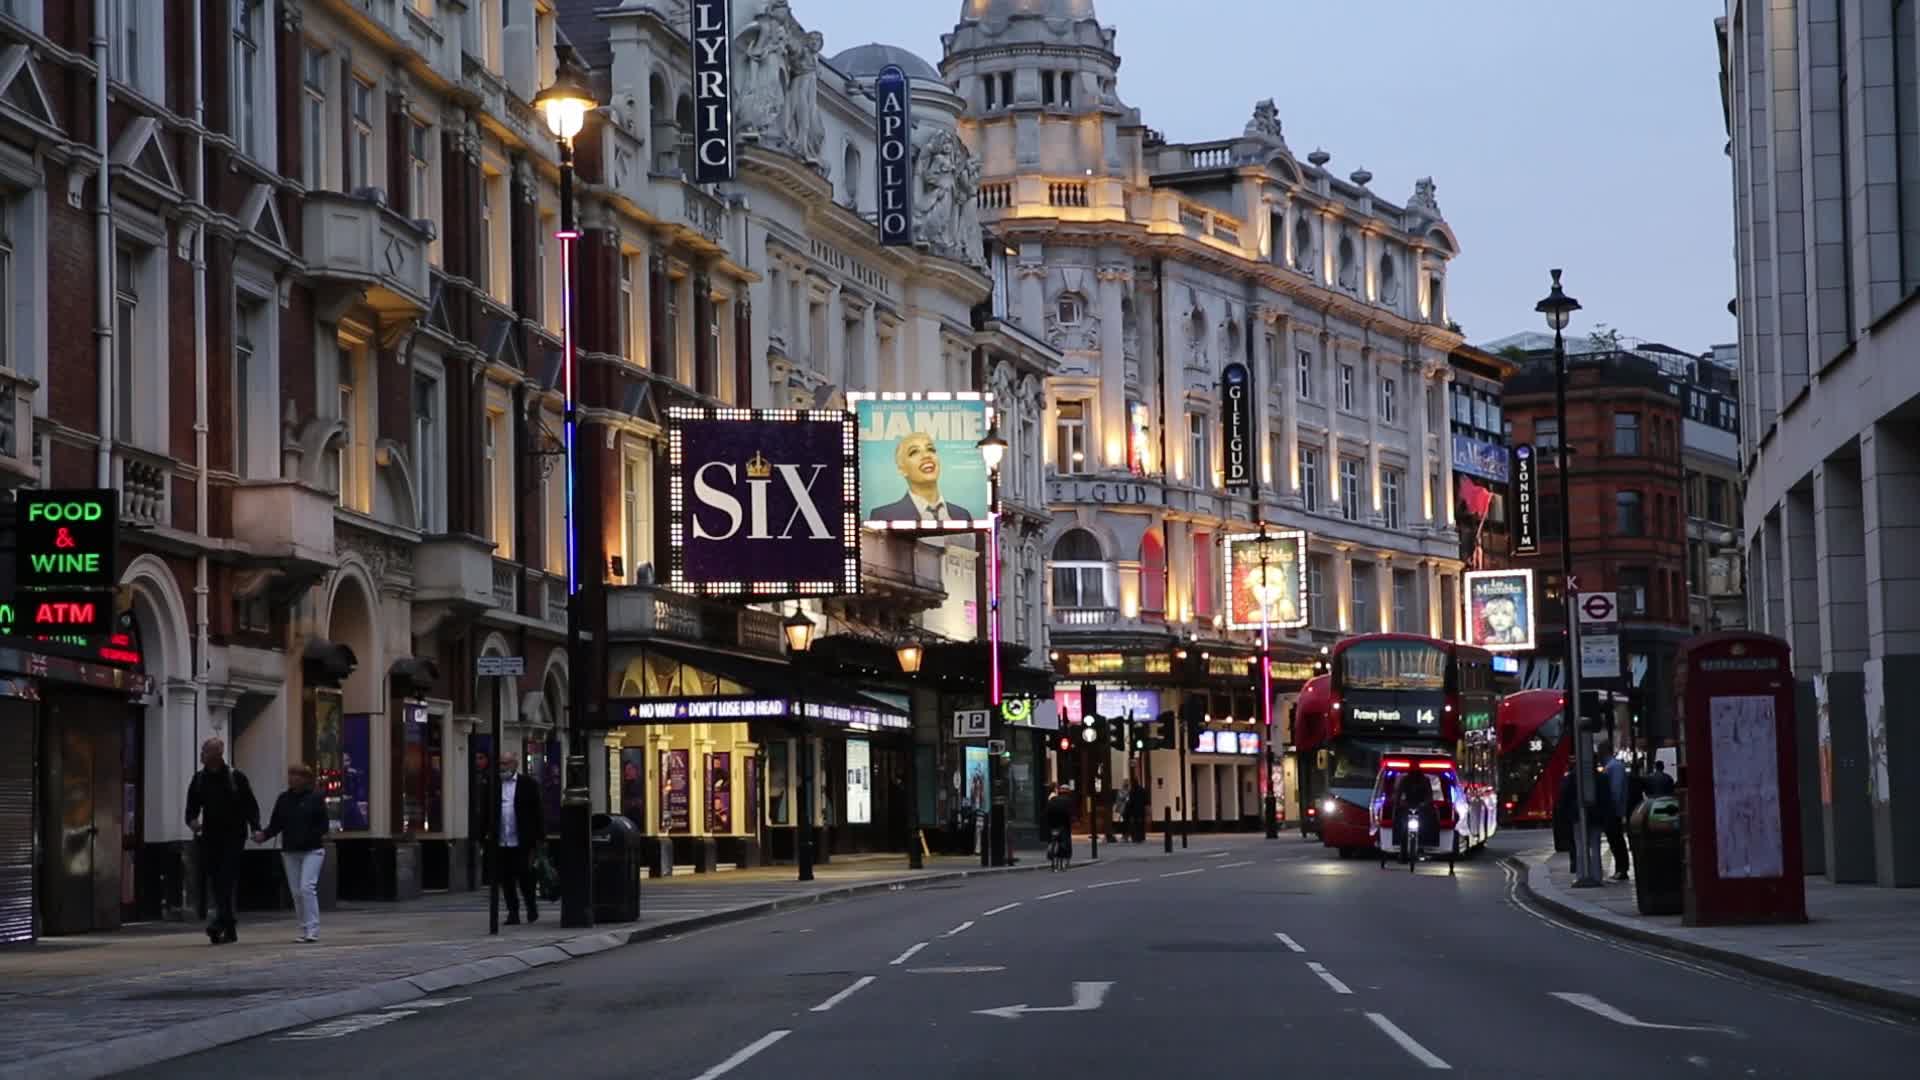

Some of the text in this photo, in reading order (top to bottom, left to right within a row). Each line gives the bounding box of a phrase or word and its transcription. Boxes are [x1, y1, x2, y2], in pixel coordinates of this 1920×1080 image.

[697, 4, 727, 166] LYRIC
[882, 92, 906, 234] APOLLO
[858, 410, 982, 441] JAMIE
[1228, 386, 1243, 478] GIELGUD
[692, 460, 837, 541] SIX
[1519, 461, 1531, 545] SONDHEIM
[28, 502, 102, 522] FOOD
[55, 527, 75, 548] &
[31, 553, 100, 573] WINE
[1567, 576, 1579, 589] K
[35, 603, 96, 624] ATM
[639, 703, 654, 718] NO
[655, 703, 677, 718] WAY
[688, 702, 716, 717] DON'T
[718, 701, 740, 716] LOSE
[741, 701, 755, 716] UR
[756, 700, 783, 715] HEAD
[1416, 709, 1434, 724] 14
[972, 715, 982, 728] P
[1529, 740, 1542, 751] 38
